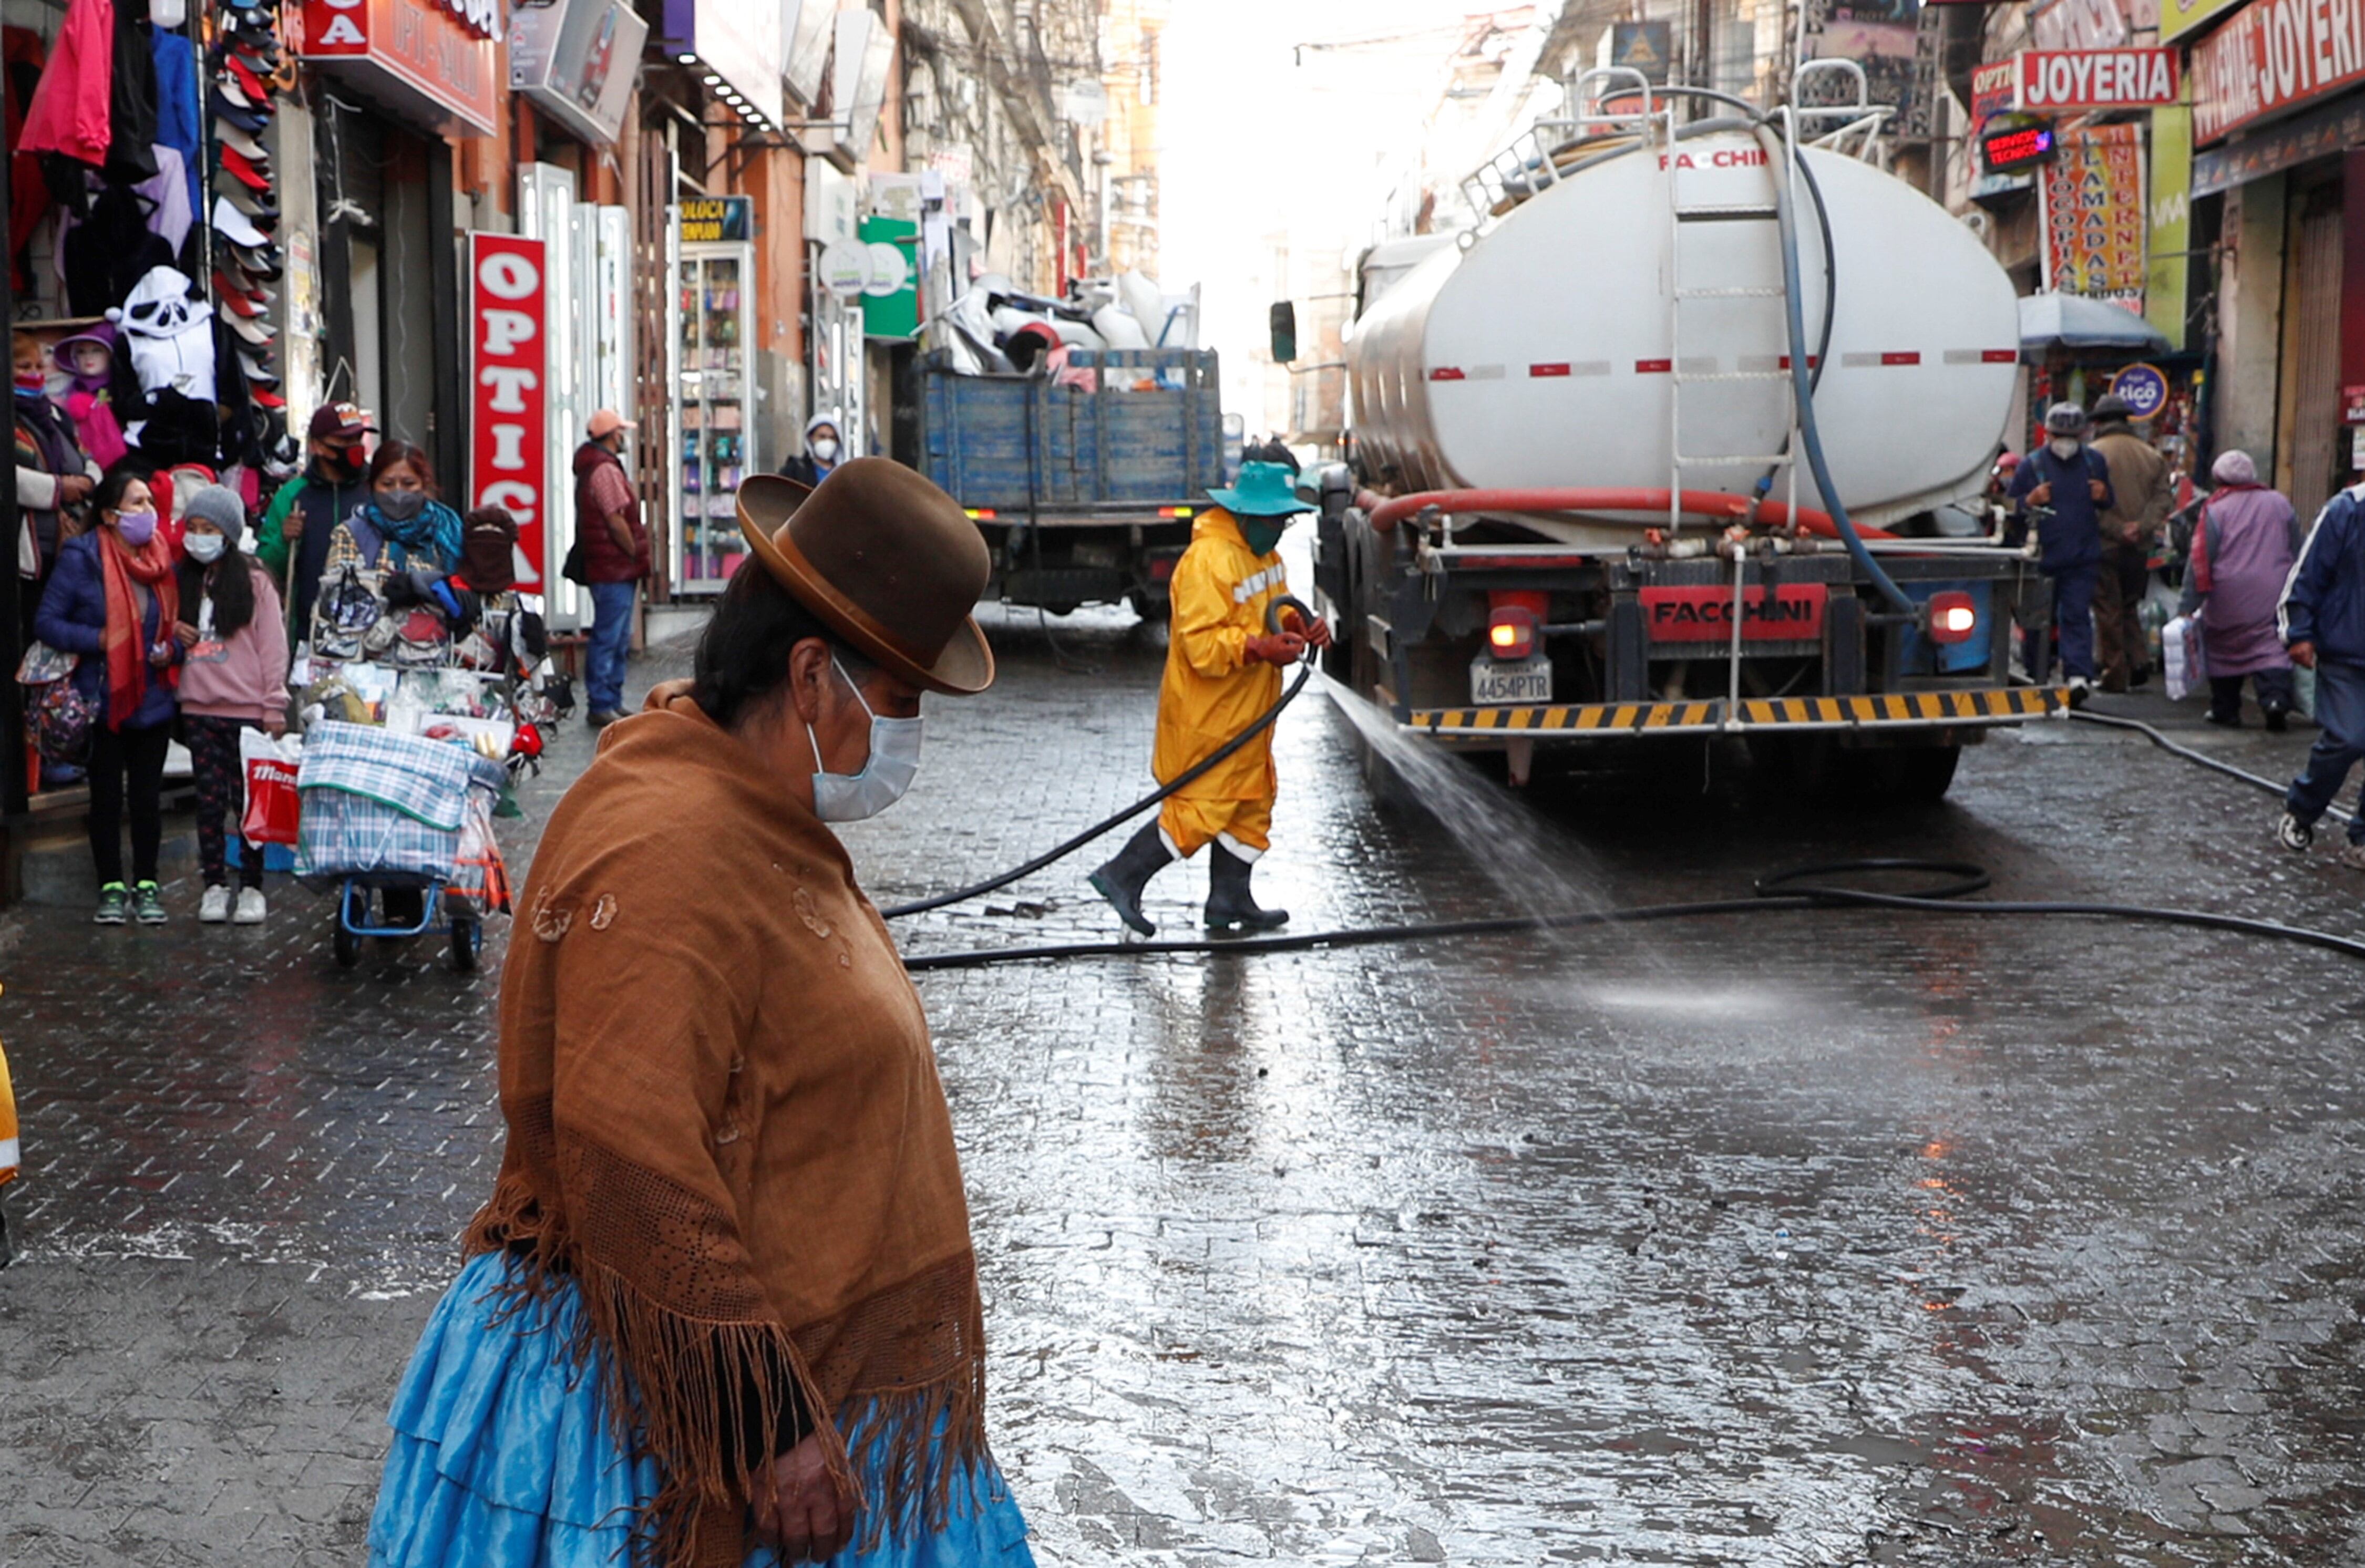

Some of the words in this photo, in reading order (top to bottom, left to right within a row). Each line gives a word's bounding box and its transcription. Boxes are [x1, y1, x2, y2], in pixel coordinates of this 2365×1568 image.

[2027, 52, 2171, 104] JOYERIA
[2260, 0, 2365, 105] JOYERI
[2081, 132, 2106, 288] LLAMADAS
[2109, 128, 2137, 284] INTERNET
[1477, 675, 1547, 698] 4454PTR
